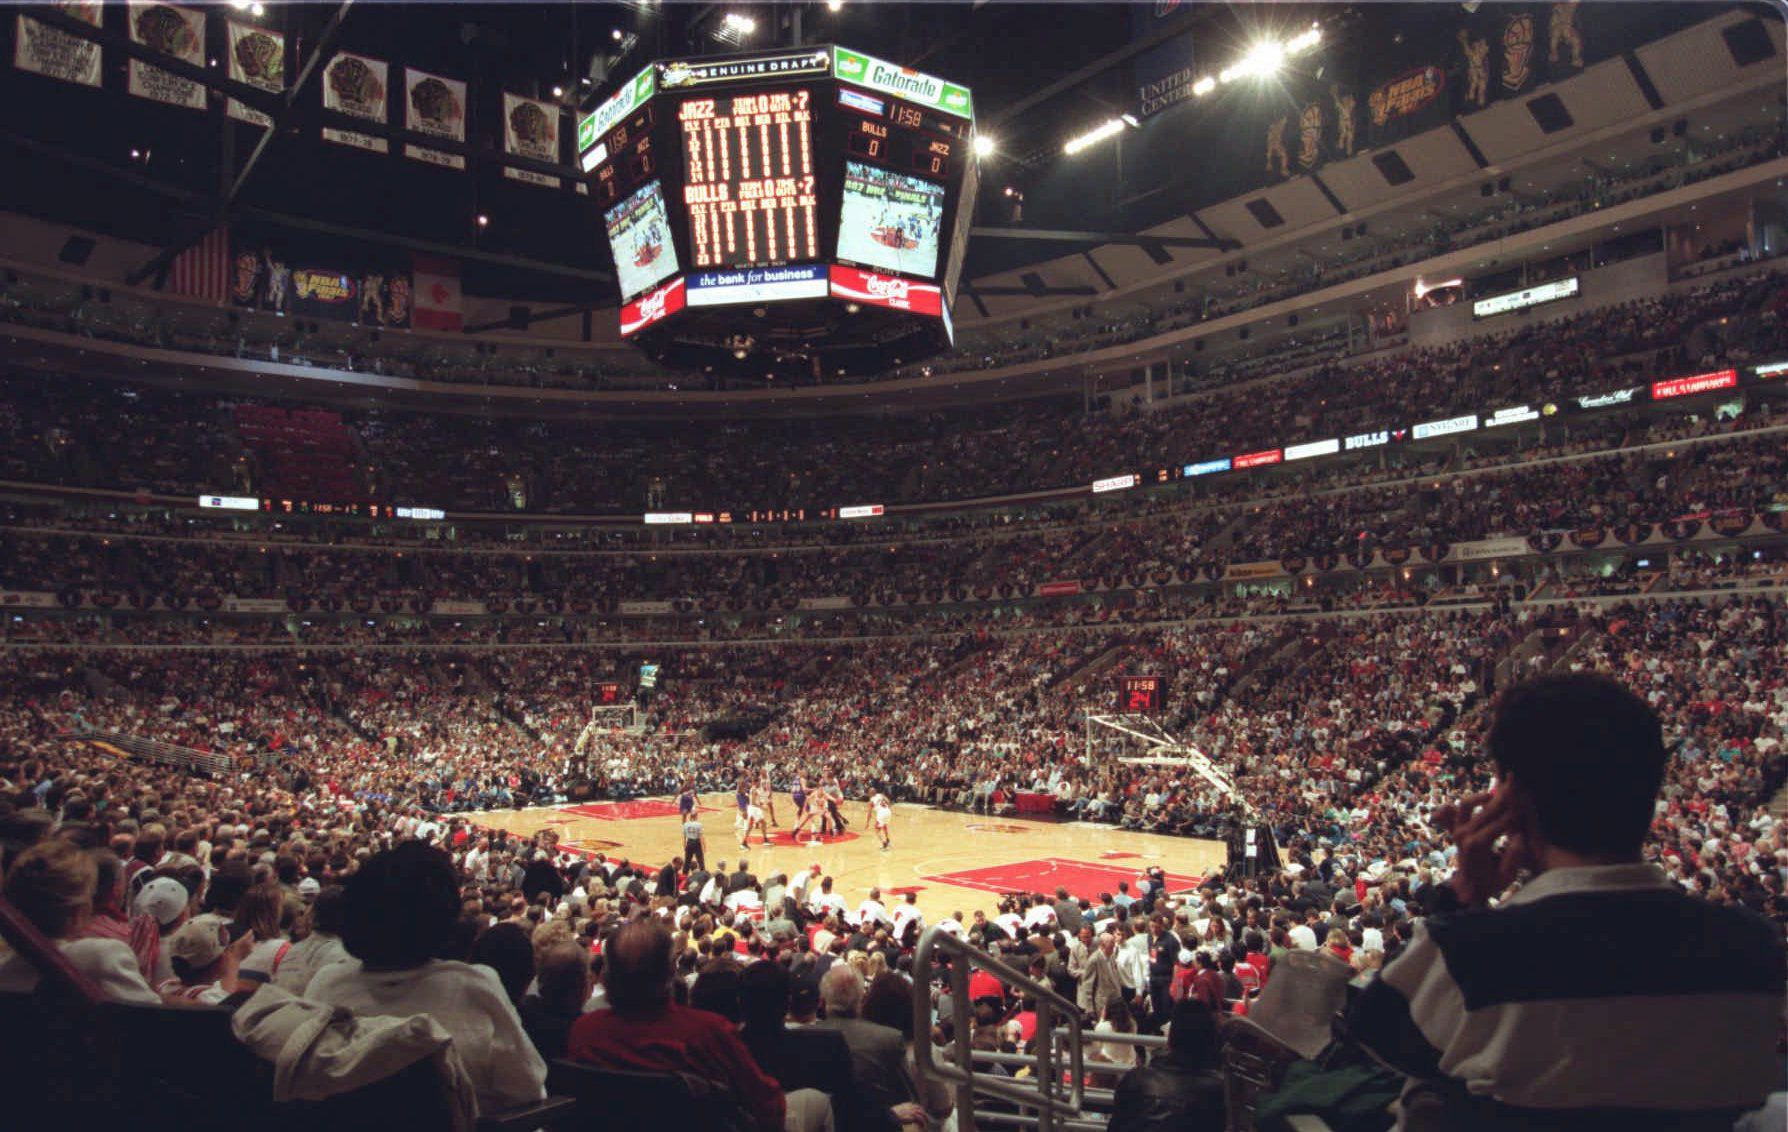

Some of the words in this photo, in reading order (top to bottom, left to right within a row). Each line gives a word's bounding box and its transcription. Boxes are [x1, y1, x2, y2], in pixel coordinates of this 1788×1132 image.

[702, 64, 765, 77] GENUINE
[770, 58, 817, 70] DRAFT
[873, 65, 936, 97] Gatorade
[1139, 68, 1191, 100] UNITED
[758, 95, 768, 113] 0
[798, 91, 808, 109] 7
[680, 100, 714, 120] JAZZ
[890, 104, 921, 127] 11:58
[862, 121, 887, 138] BULLS
[869, 140, 879, 156] 0
[929, 141, 950, 156] JAZZ
[931, 158, 940, 173] 0
[684, 183, 728, 203] BULLS
[764, 179, 774, 197] 0
[804, 176, 813, 193] 7
[700, 274, 716, 286] the
[718, 273, 745, 284] bank
[746, 270, 763, 285] for
[764, 269, 814, 281] business
[1345, 431, 1389, 449] BULLS
[1127, 680, 1155, 691] 11:58
